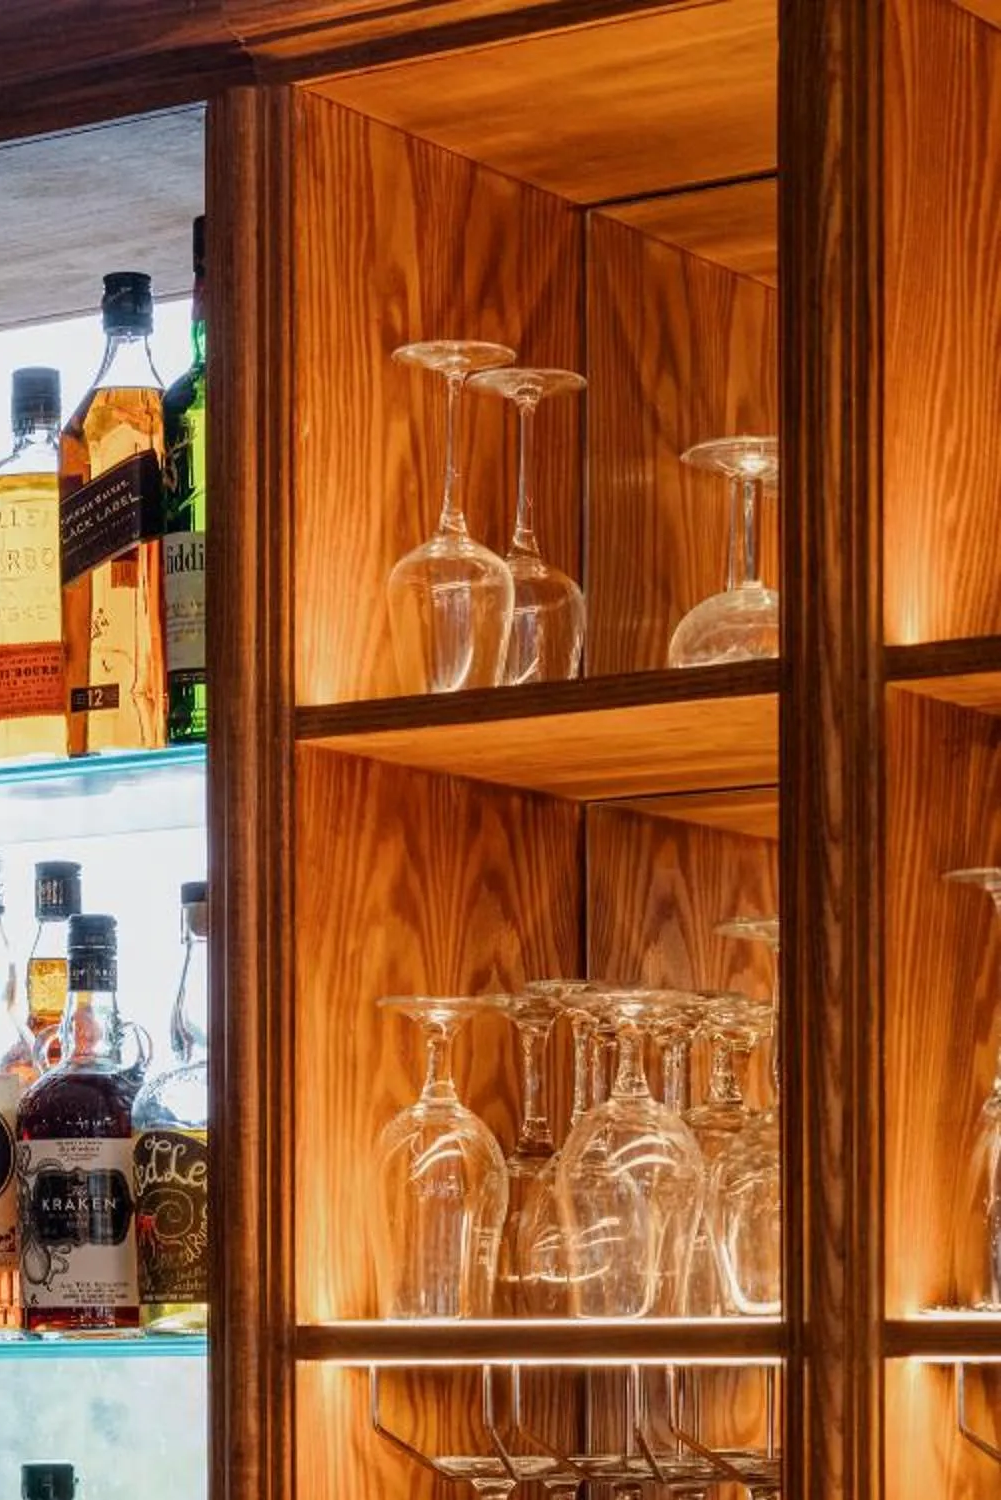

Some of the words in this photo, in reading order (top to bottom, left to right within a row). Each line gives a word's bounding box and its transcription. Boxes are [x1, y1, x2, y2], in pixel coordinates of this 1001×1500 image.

[95, 492, 141, 522] LABEL
[87, 690, 102, 707] 12
[42, 1198, 118, 1212] KRAKEN
